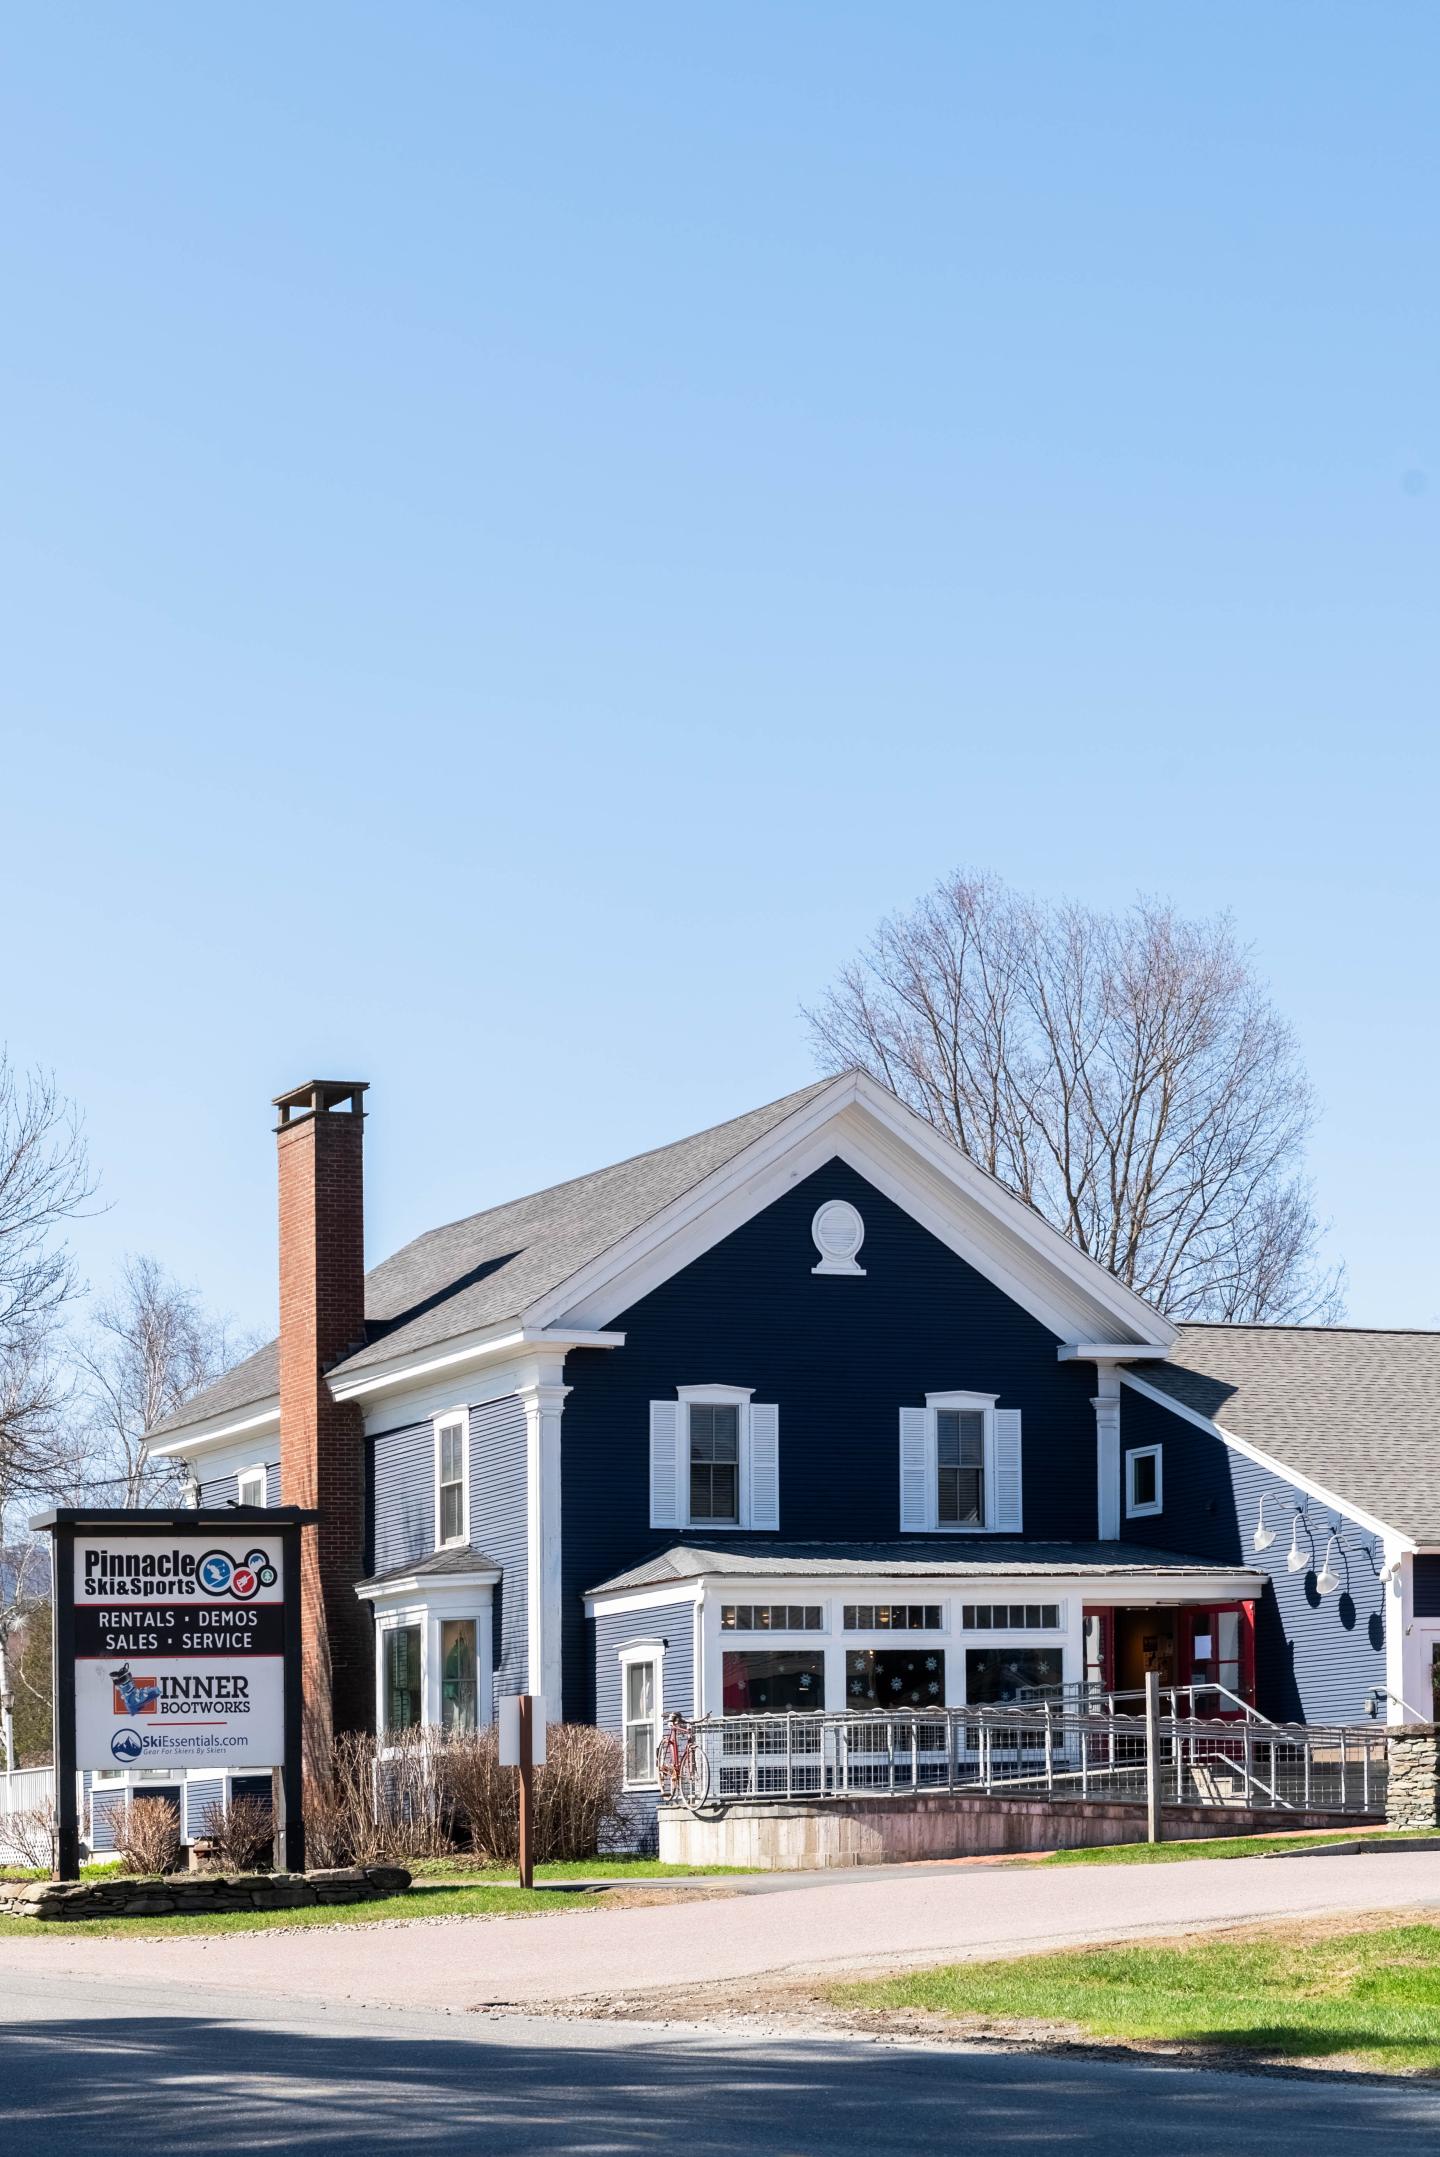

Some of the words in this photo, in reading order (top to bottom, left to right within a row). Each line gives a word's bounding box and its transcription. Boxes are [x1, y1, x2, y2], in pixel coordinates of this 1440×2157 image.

[85, 1550, 196, 1577] Pinnacle
[84, 1577, 196, 1596] Ski&Sports
[99, 1611, 175, 1627] RENTALS
[199, 1610, 258, 1626] DEMOS
[106, 1634, 158, 1650] SALES
[182, 1633, 252, 1648] SERVICE
[160, 1675, 249, 1699] INNER
[160, 1700, 251, 1714] BOOTWORKS
[142, 1734, 248, 1747] SkiEssentials.com
[196, 1747, 205, 1755] By
